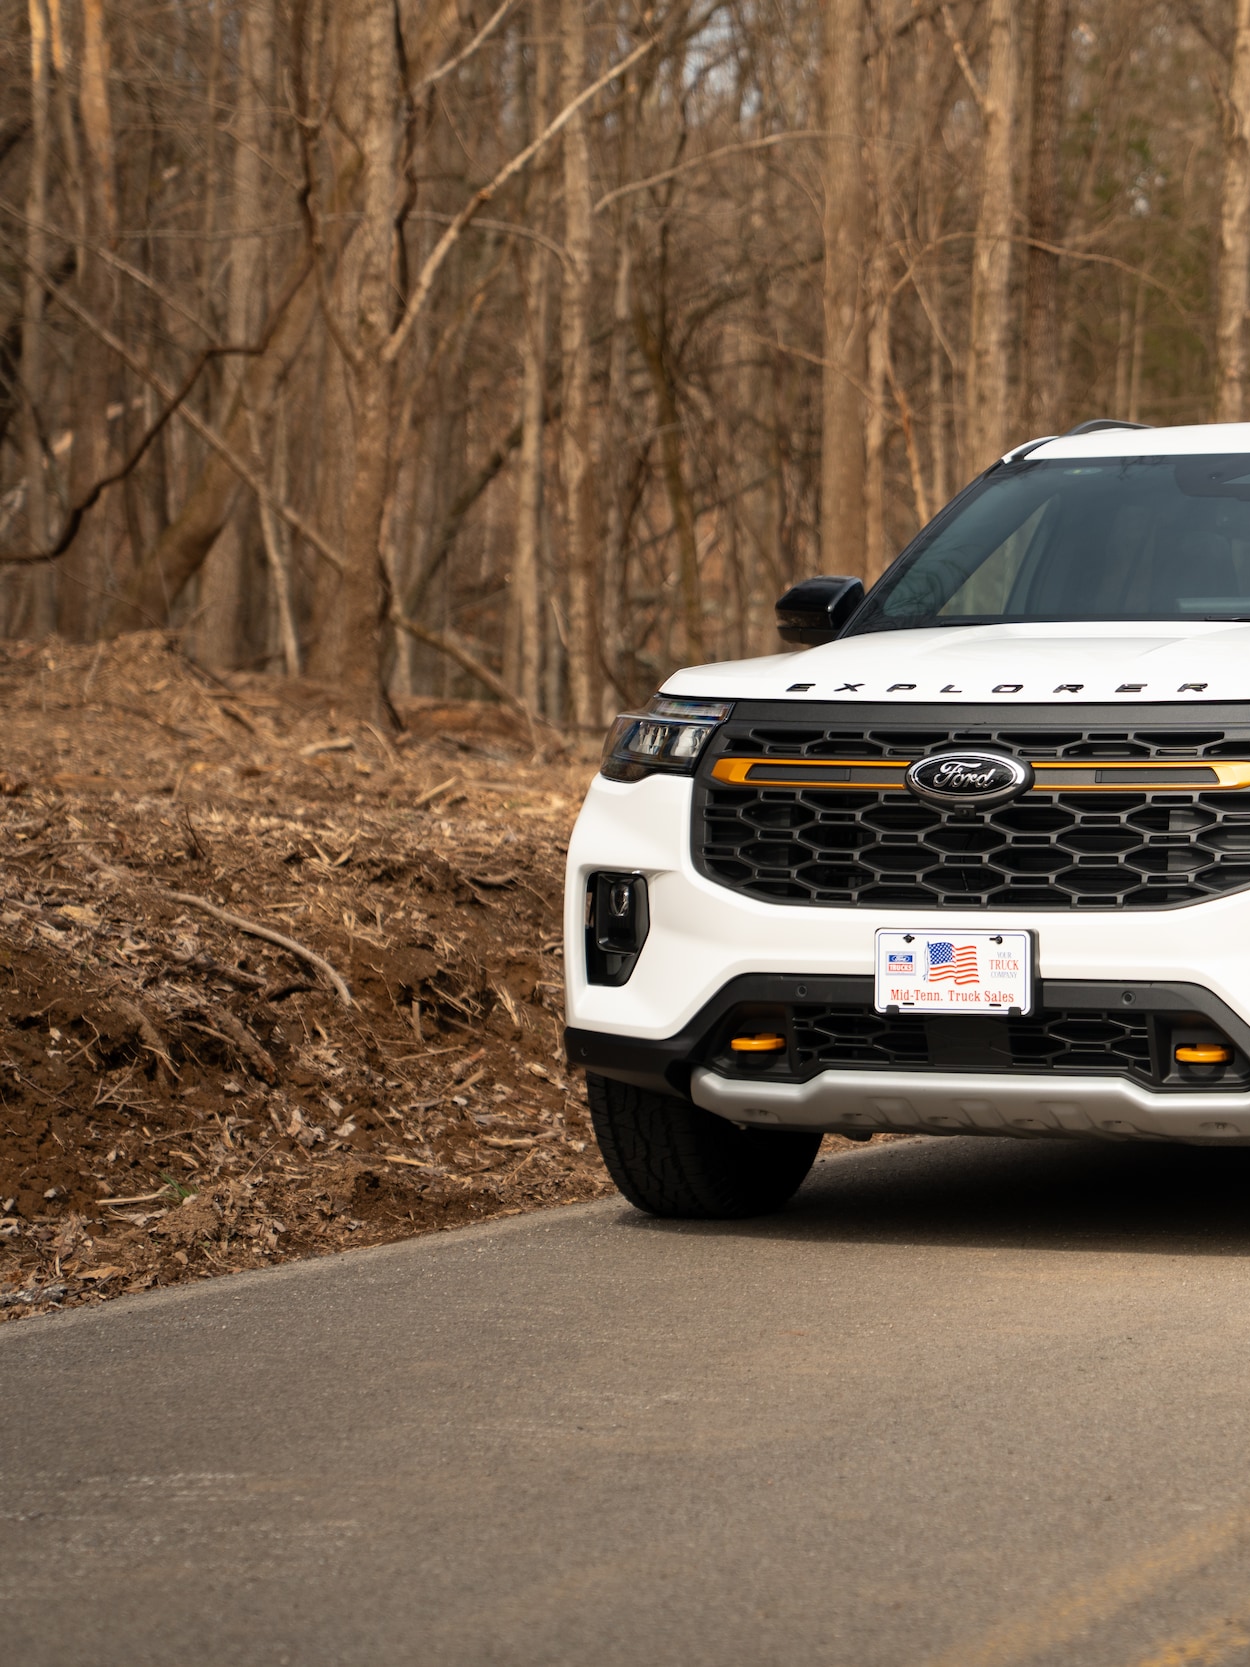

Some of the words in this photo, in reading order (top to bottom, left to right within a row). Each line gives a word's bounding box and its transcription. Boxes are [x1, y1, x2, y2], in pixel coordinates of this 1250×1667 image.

[785, 683, 1209, 694] EXPLORER
[933, 761, 996, 788] Ford
[997, 951, 1012, 959] YOUR
[989, 959, 1019, 971] TRUCK
[990, 971, 1018, 979] COMPANY
[890, 989, 943, 1001] Mid-Tenn.
[948, 990, 981, 1002] Truck
[984, 990, 1015, 1003] Sales
